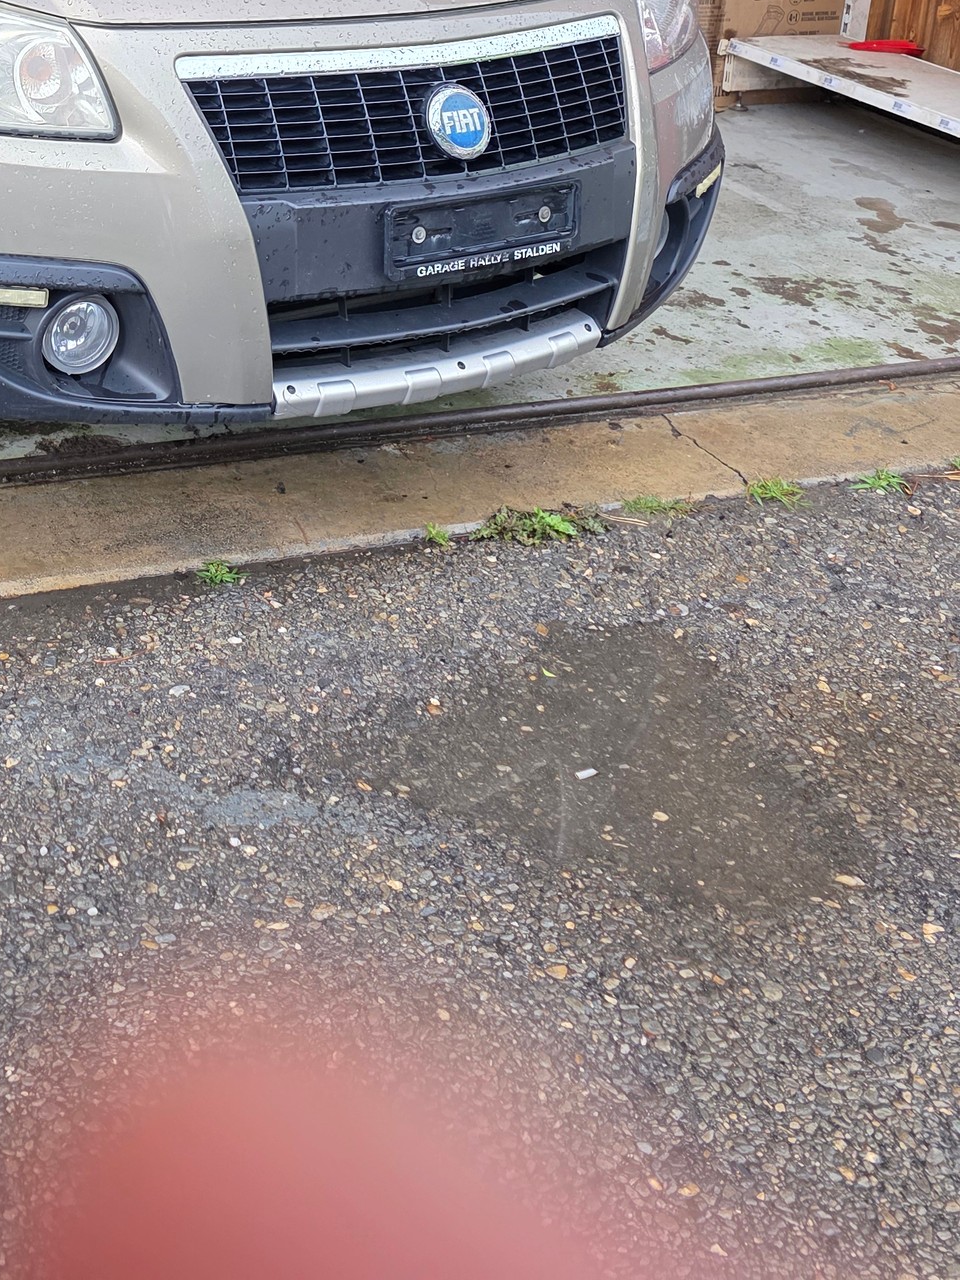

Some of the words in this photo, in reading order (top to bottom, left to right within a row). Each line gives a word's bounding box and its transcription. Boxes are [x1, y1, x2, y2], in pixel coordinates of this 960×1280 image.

[441, 107, 482, 135] FIAT
[416, 259, 466, 277] GARAGE
[513, 242, 561, 261] STALDEN
